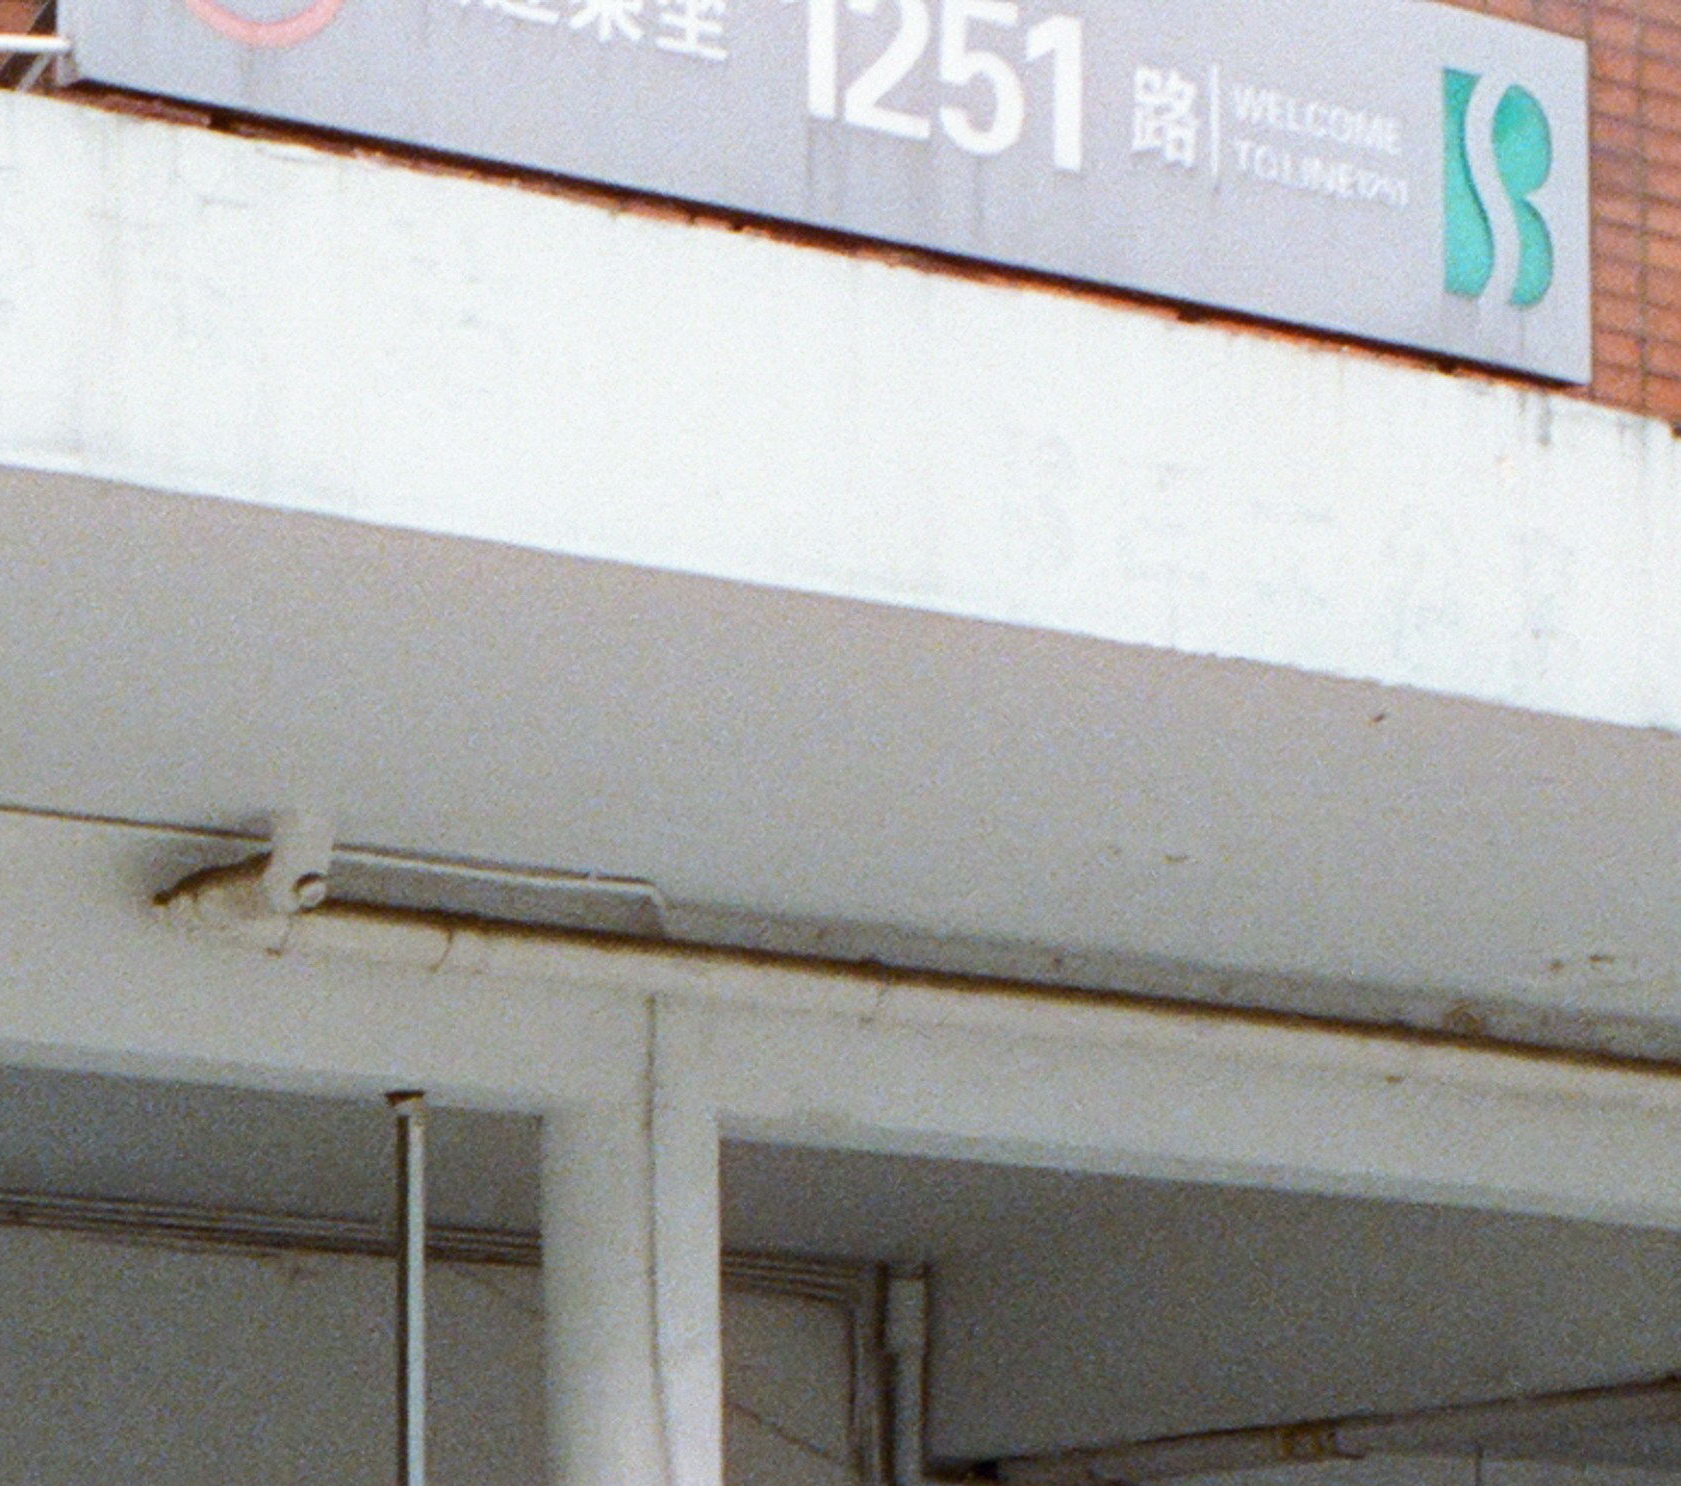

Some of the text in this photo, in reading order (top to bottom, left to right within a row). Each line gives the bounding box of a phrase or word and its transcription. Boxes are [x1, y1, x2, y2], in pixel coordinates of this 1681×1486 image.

[807, 0, 1083, 172] 1251
[1131, 63, 1198, 169] 路
[1233, 82, 1404, 155] WELCOME
